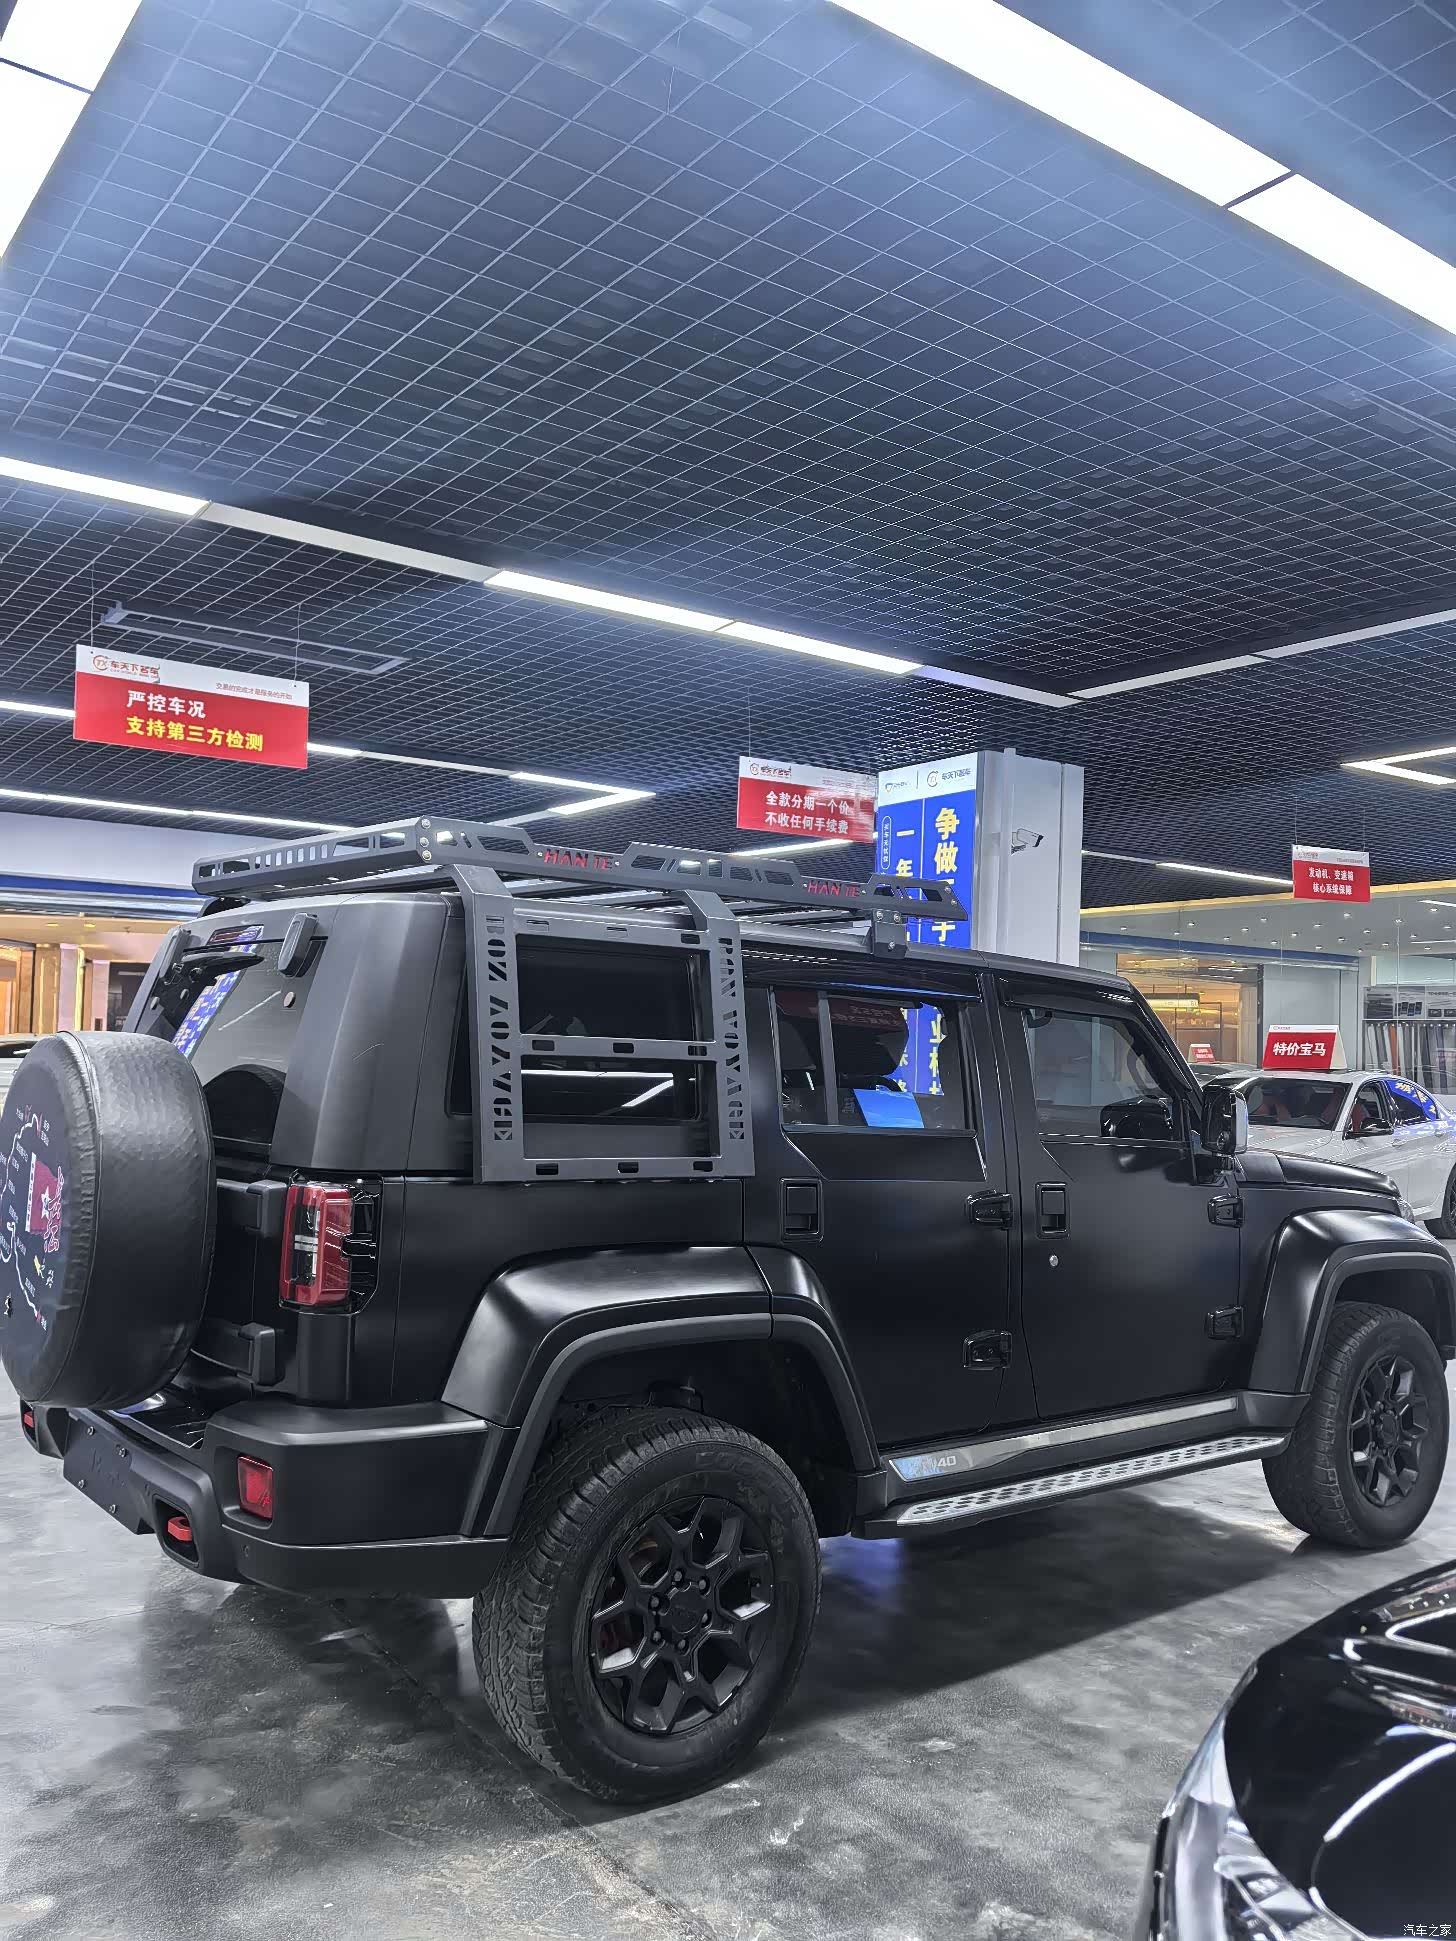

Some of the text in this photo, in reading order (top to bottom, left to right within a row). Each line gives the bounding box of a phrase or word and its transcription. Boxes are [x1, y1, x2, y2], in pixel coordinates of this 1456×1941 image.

[126, 690, 207, 719] 严控车况
[126, 716, 264, 752] 支持第三方检测
[765, 790, 854, 817] 全款分期一个价
[764, 811, 848, 835] 不收任何手续费
[1272, 1041, 1326, 1057] 特价宝马
